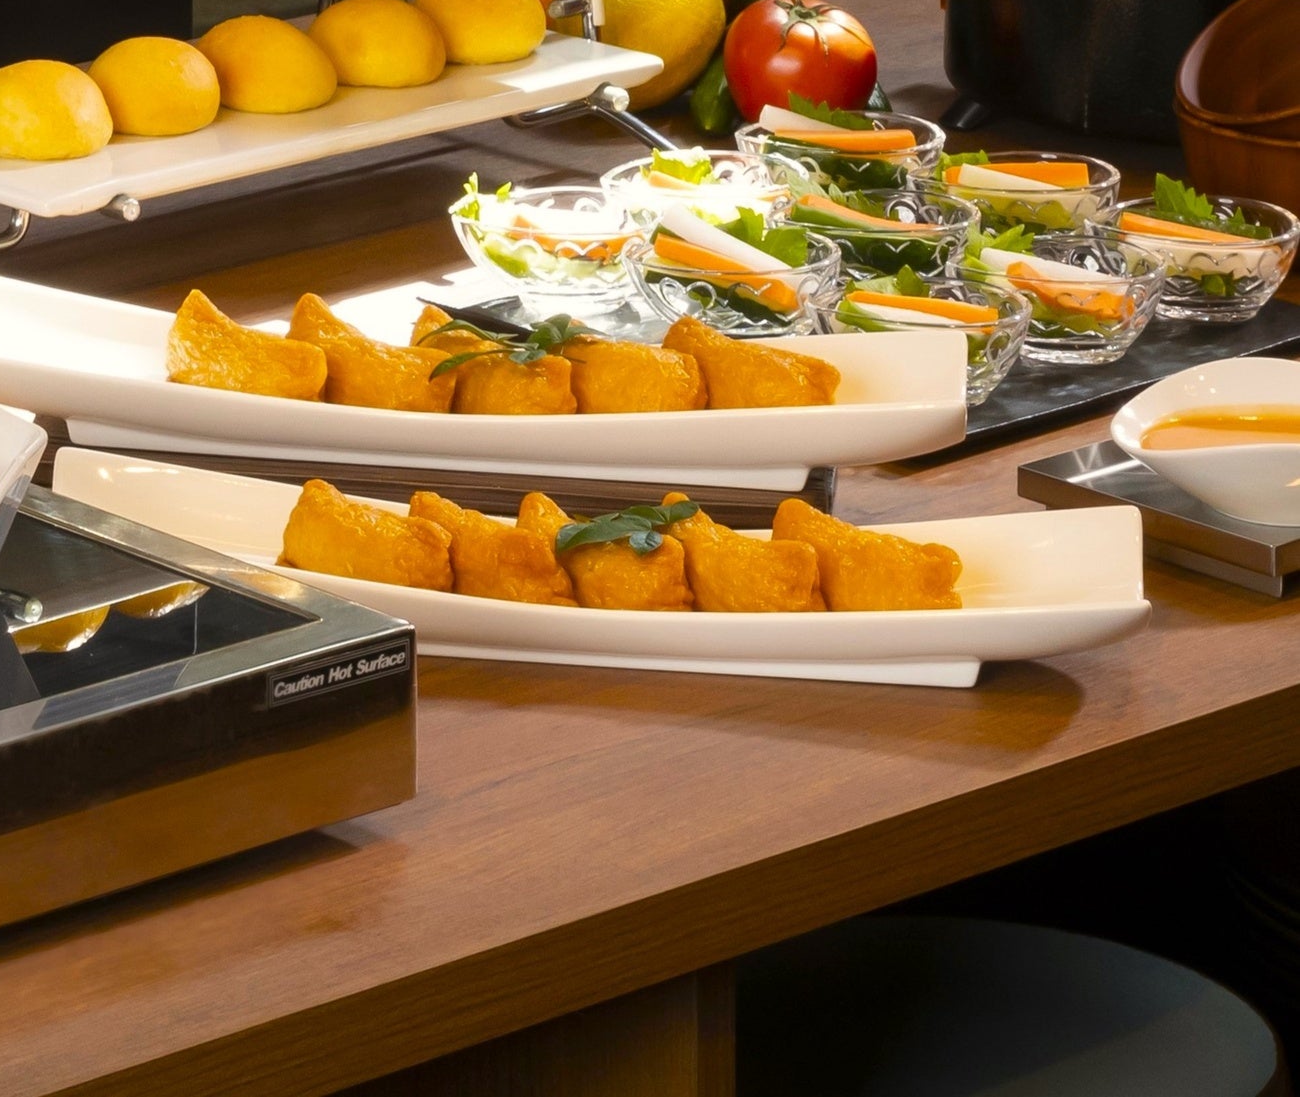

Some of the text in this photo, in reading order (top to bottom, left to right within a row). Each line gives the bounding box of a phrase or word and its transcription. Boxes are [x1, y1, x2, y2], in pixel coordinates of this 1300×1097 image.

[274, 652, 405, 698] Caution Hot Surface
